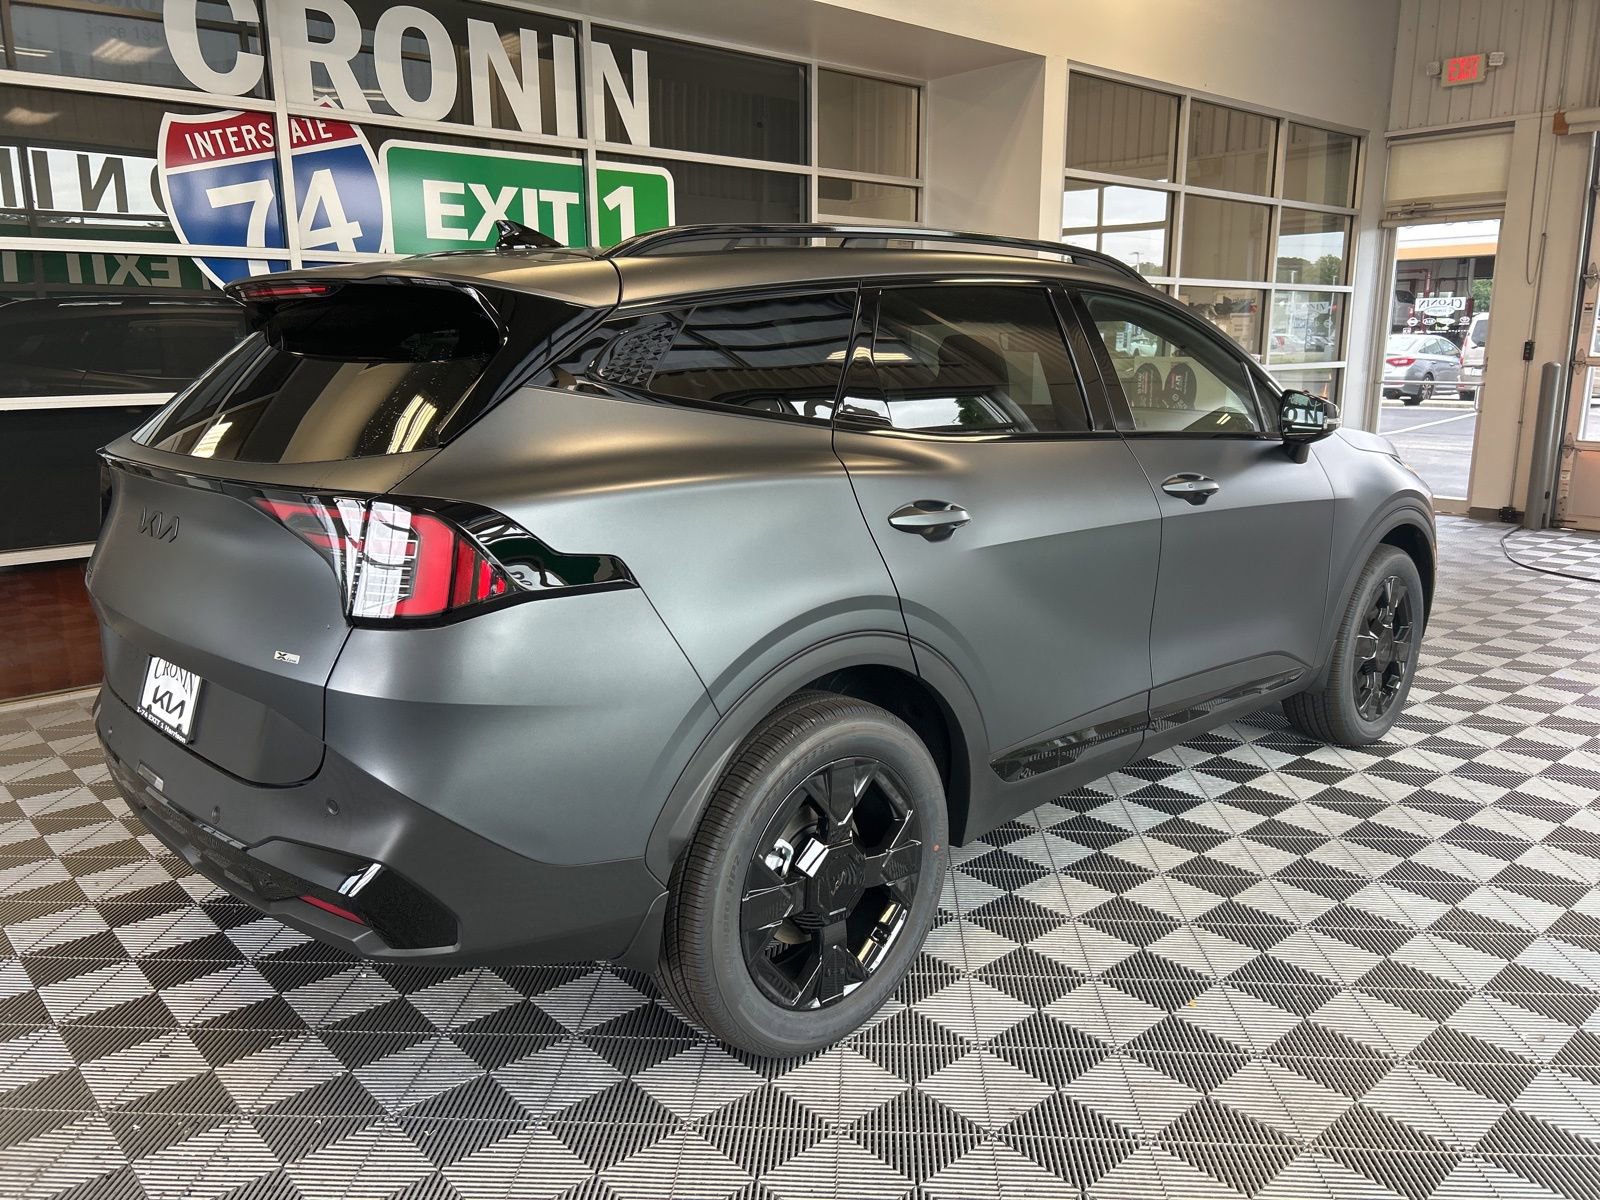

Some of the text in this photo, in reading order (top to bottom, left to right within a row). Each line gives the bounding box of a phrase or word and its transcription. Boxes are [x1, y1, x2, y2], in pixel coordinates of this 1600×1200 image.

[163, 0, 650, 148] CRONIN
[1447, 55, 1480, 83] EXIT
[185, 115, 333, 160] INTERSATE
[206, 168, 363, 277] 74
[422, 179, 636, 248] EXIT 1
